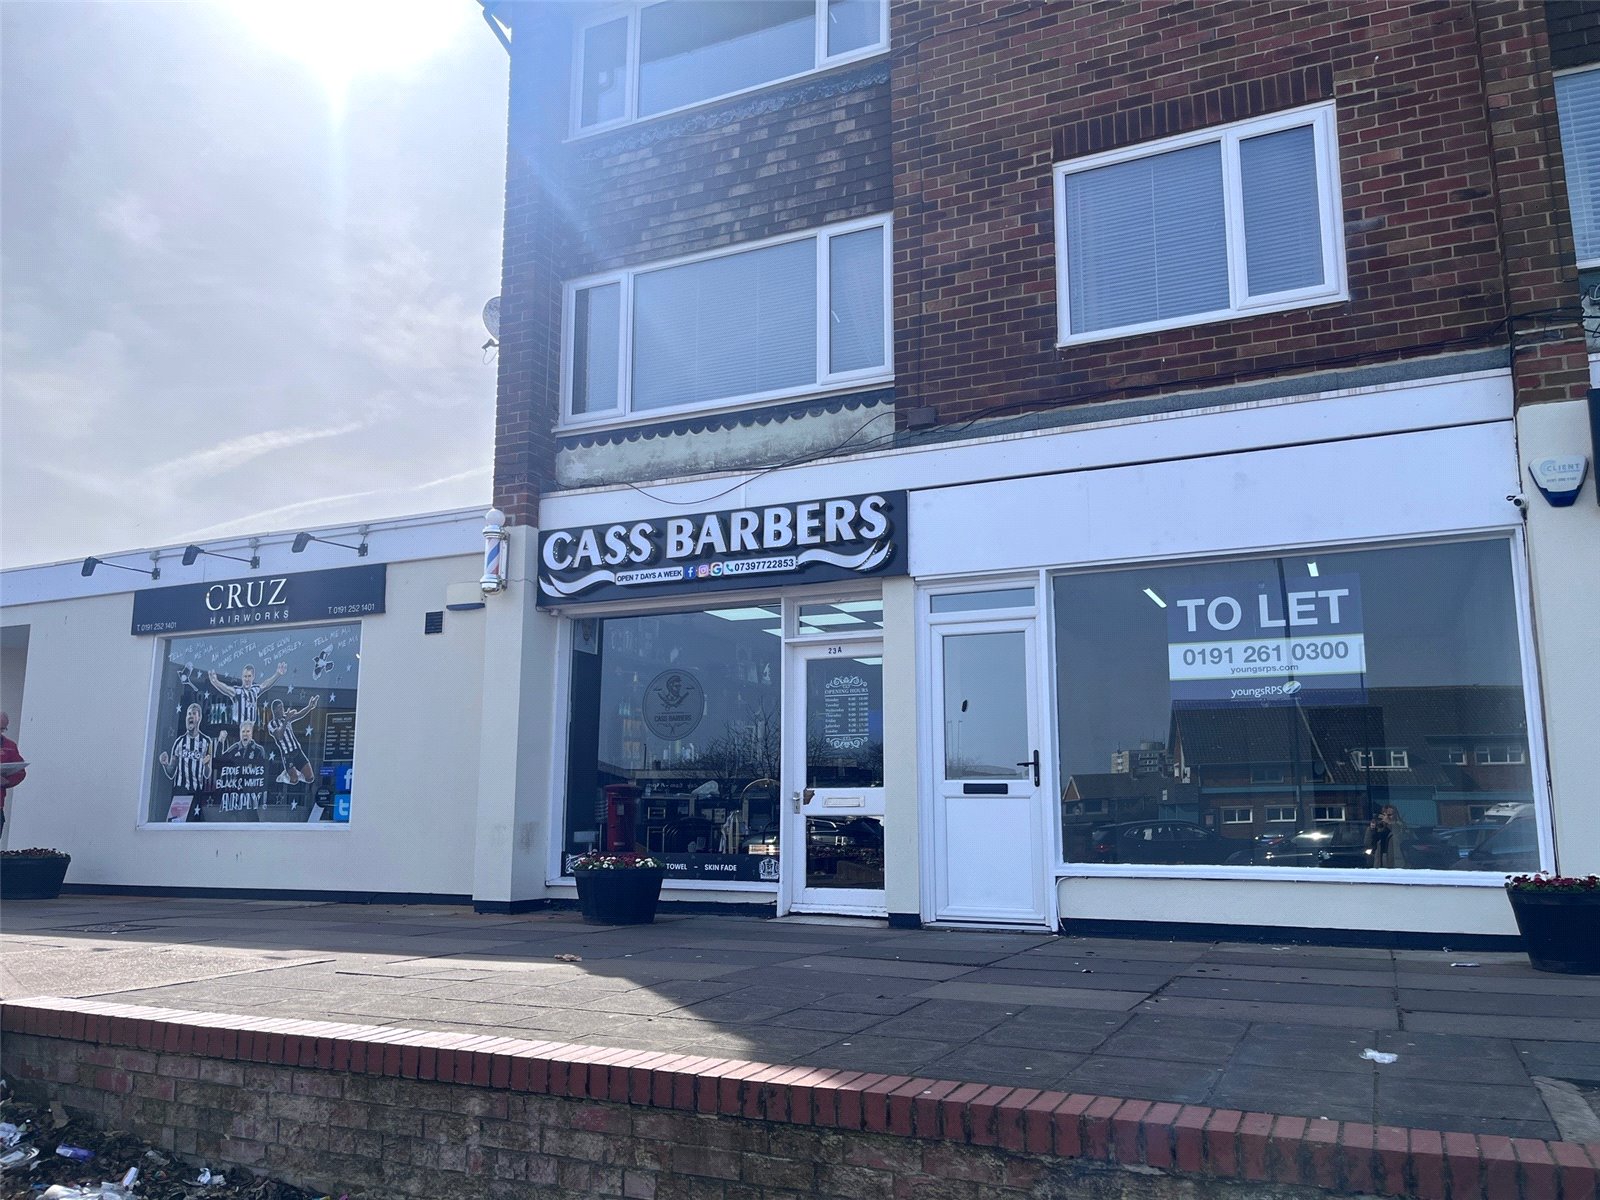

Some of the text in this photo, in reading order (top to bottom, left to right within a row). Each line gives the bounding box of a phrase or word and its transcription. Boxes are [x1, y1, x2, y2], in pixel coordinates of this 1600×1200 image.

[1546, 463, 1580, 472] CLIENT
[543, 495, 890, 571] CASS BARBERS
[734, 559, 794, 572] 07397722853
[616, 574, 634, 582] OPEN
[640, 572, 657, 580] DAYS
[205, 578, 288, 611] CRUZ
[328, 603, 375, 614] T 0191 252 1401
[1176, 588, 1349, 632] TO LET
[209, 610, 289, 625] HAIRWORKS
[141, 623, 153, 631] 0191
[153, 622, 164, 630] 252
[165, 621, 177, 629] 1401
[1183, 641, 1349, 666] 0191 261 0300
[1230, 664, 1299, 674] youngsrps.com
[1231, 684, 1283, 698] youngsRPS
[221, 766, 264, 775] EDDIE HOWES
[216, 780, 237, 789] BLACK
[244, 778, 264, 787] WHITE
[221, 791, 268, 812] ARMY!
[704, 863, 720, 871] SKIN
